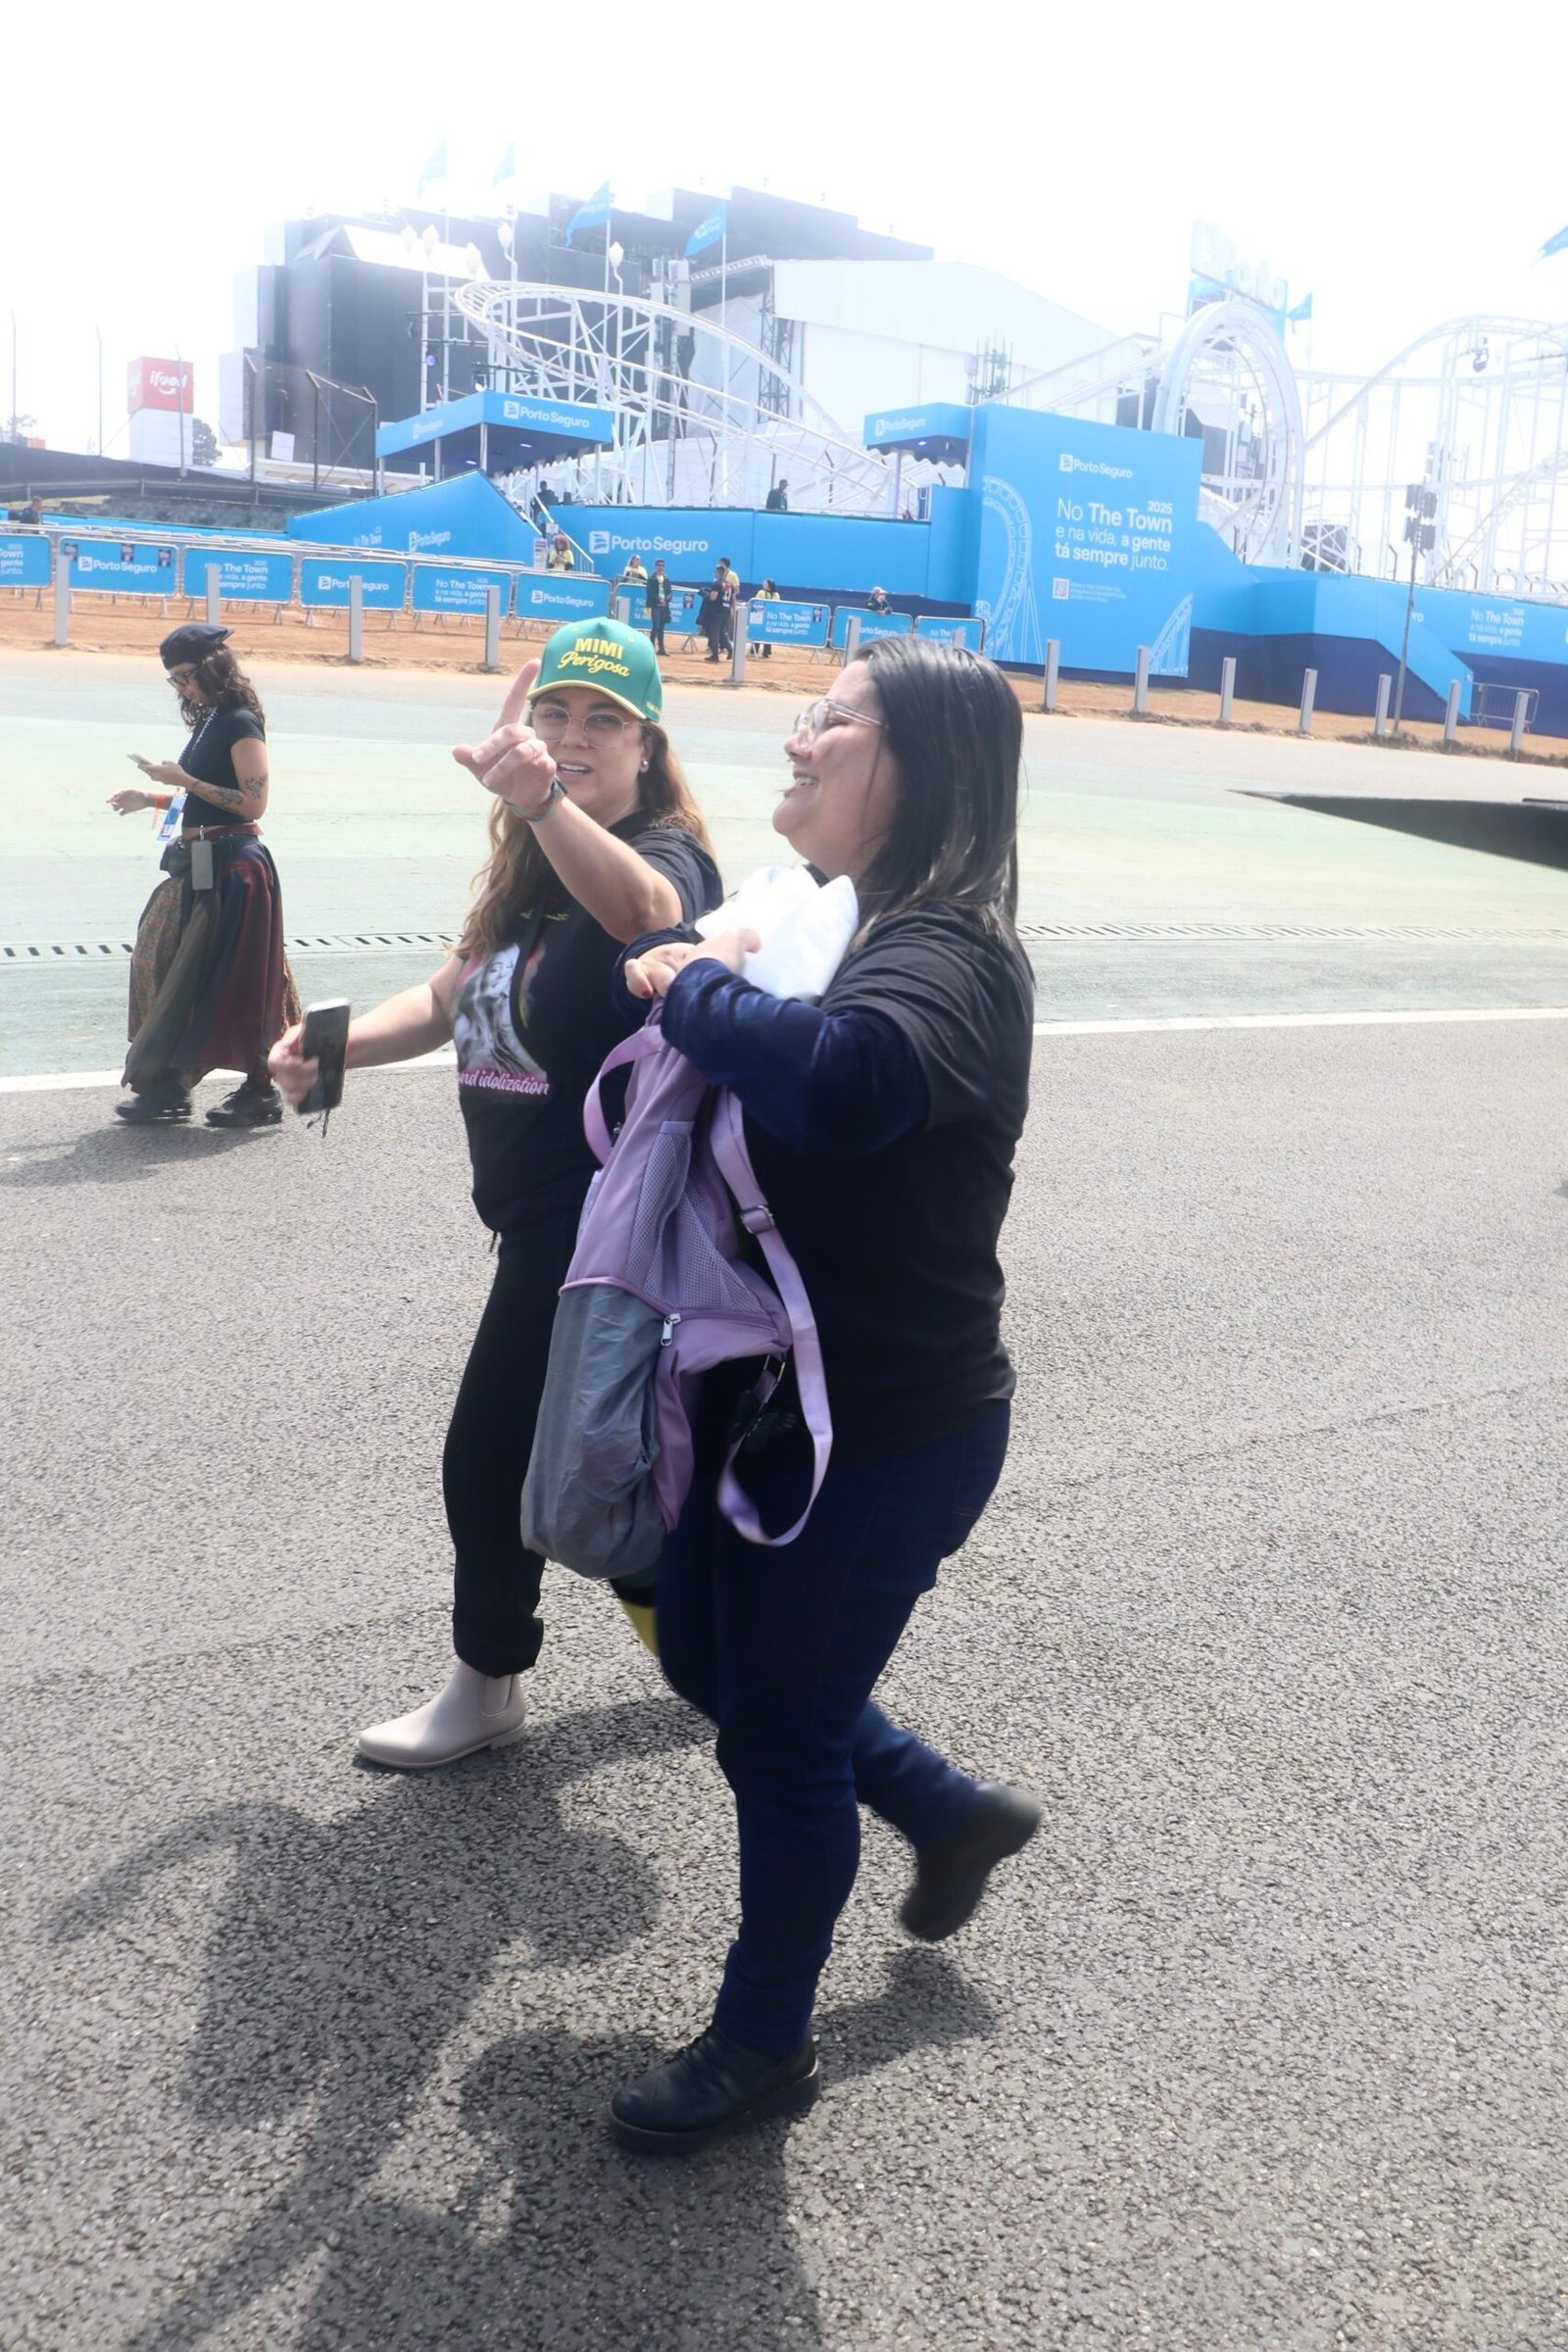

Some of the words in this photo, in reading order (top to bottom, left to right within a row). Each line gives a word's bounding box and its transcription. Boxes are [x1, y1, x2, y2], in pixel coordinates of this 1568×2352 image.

[1057, 497, 1084, 521] No
[1088, 502, 1122, 527] The
[1126, 507, 1173, 534] Town
[1148, 500, 1173, 514] 2025
[1055, 525, 1065, 539] e
[1067, 526, 1085, 541] na
[1120, 534, 1130, 548] a
[1132, 536, 1172, 553] gente
[1054, 541, 1070, 560] tá
[1072, 546, 1129, 568] sempre
[223, 563, 241, 573] The
[243, 564, 269, 574] Town
[1486, 612, 1501, 624] The
[1502, 613, 1524, 627] Town
[574, 638, 624, 660] MIMI
[557, 651, 630, 677] Perigosa
